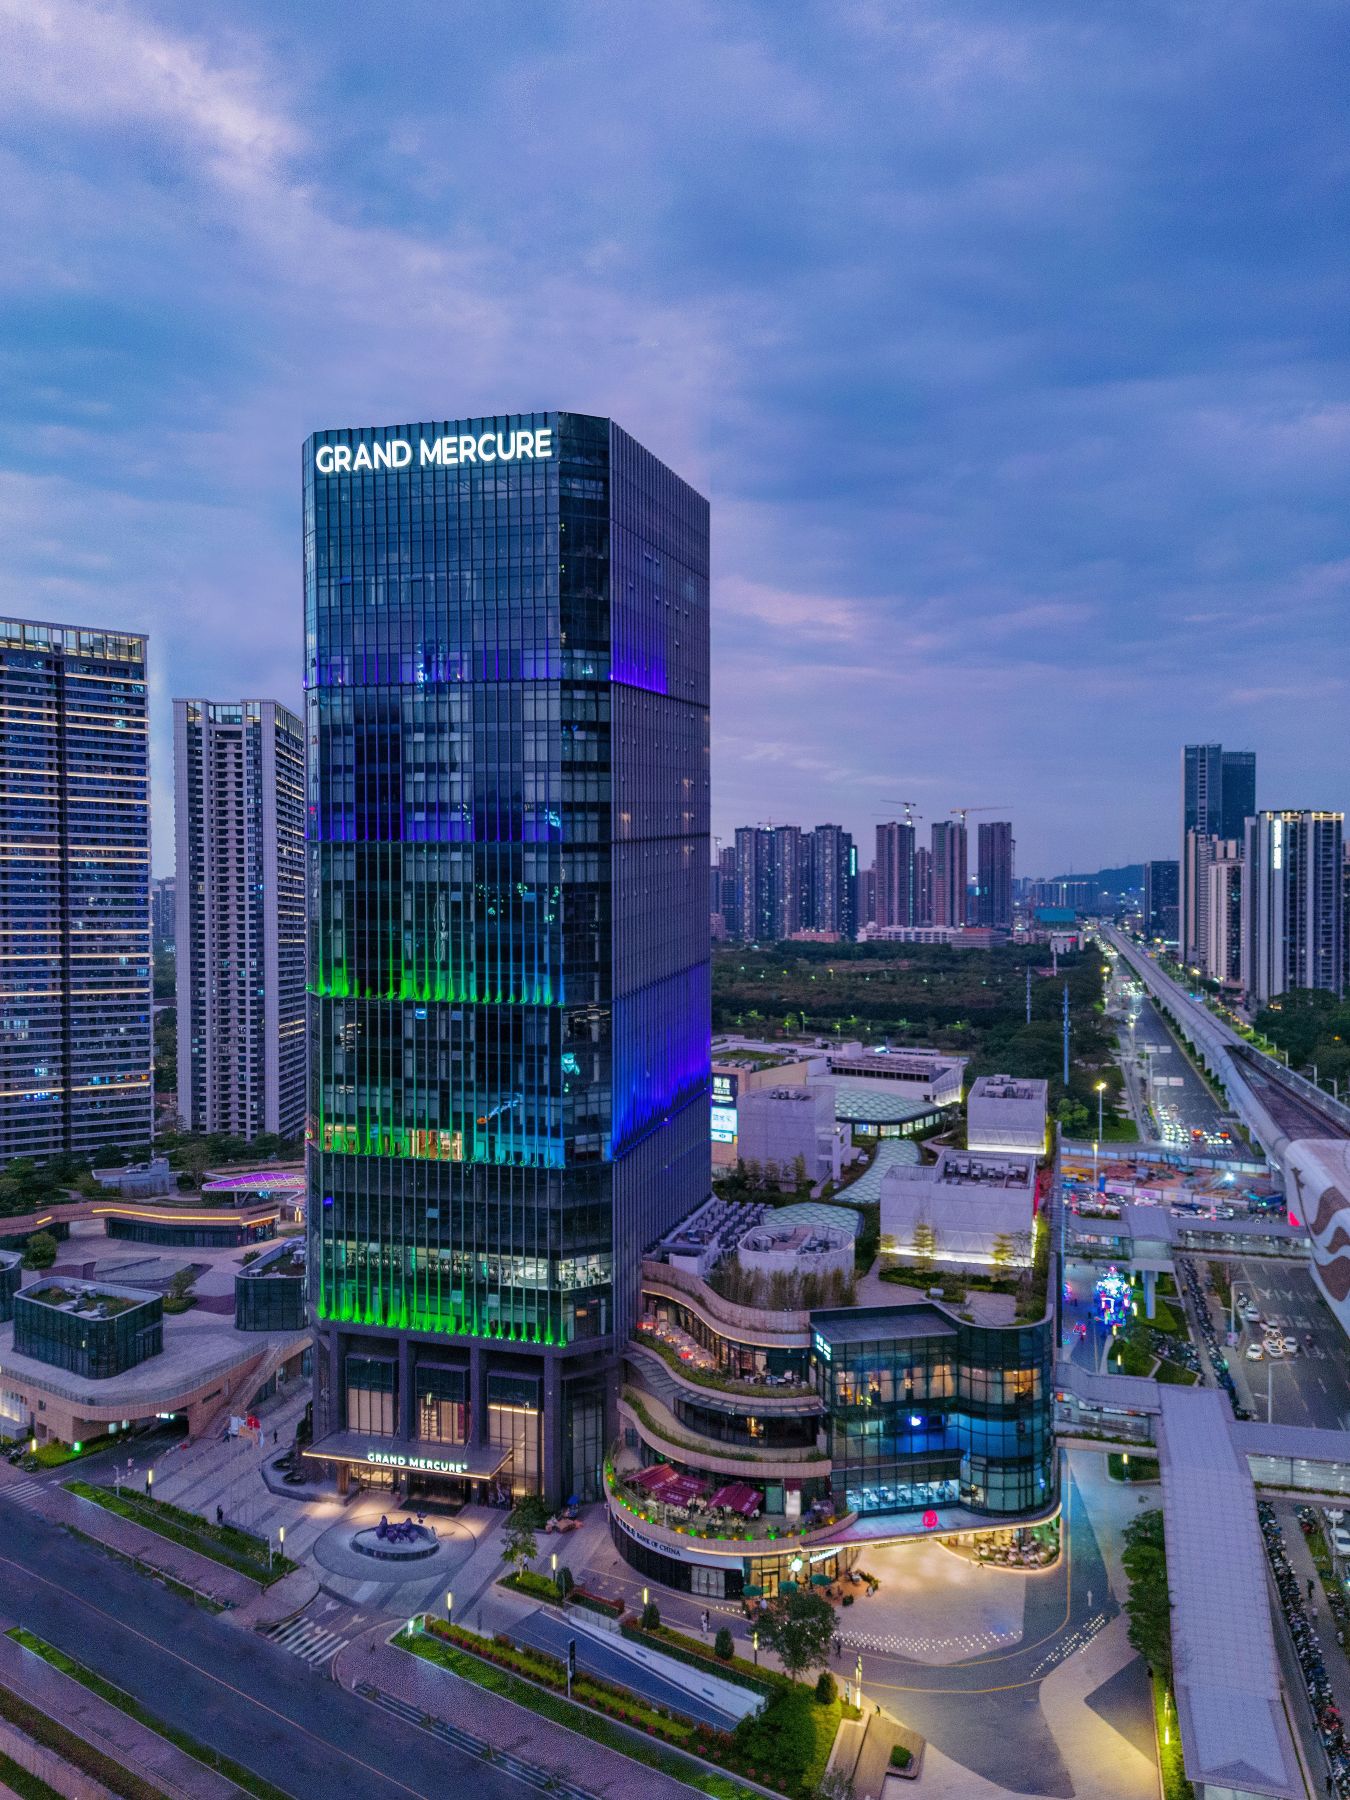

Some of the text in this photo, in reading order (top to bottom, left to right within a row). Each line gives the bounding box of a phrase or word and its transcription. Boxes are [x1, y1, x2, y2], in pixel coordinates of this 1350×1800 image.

[316, 429, 552, 473] GRAND MERCURE
[367, 1453, 462, 1473] GRAND MERCURE
[636, 1532, 651, 1545] BANK
[659, 1544, 681, 1557] CHINA
